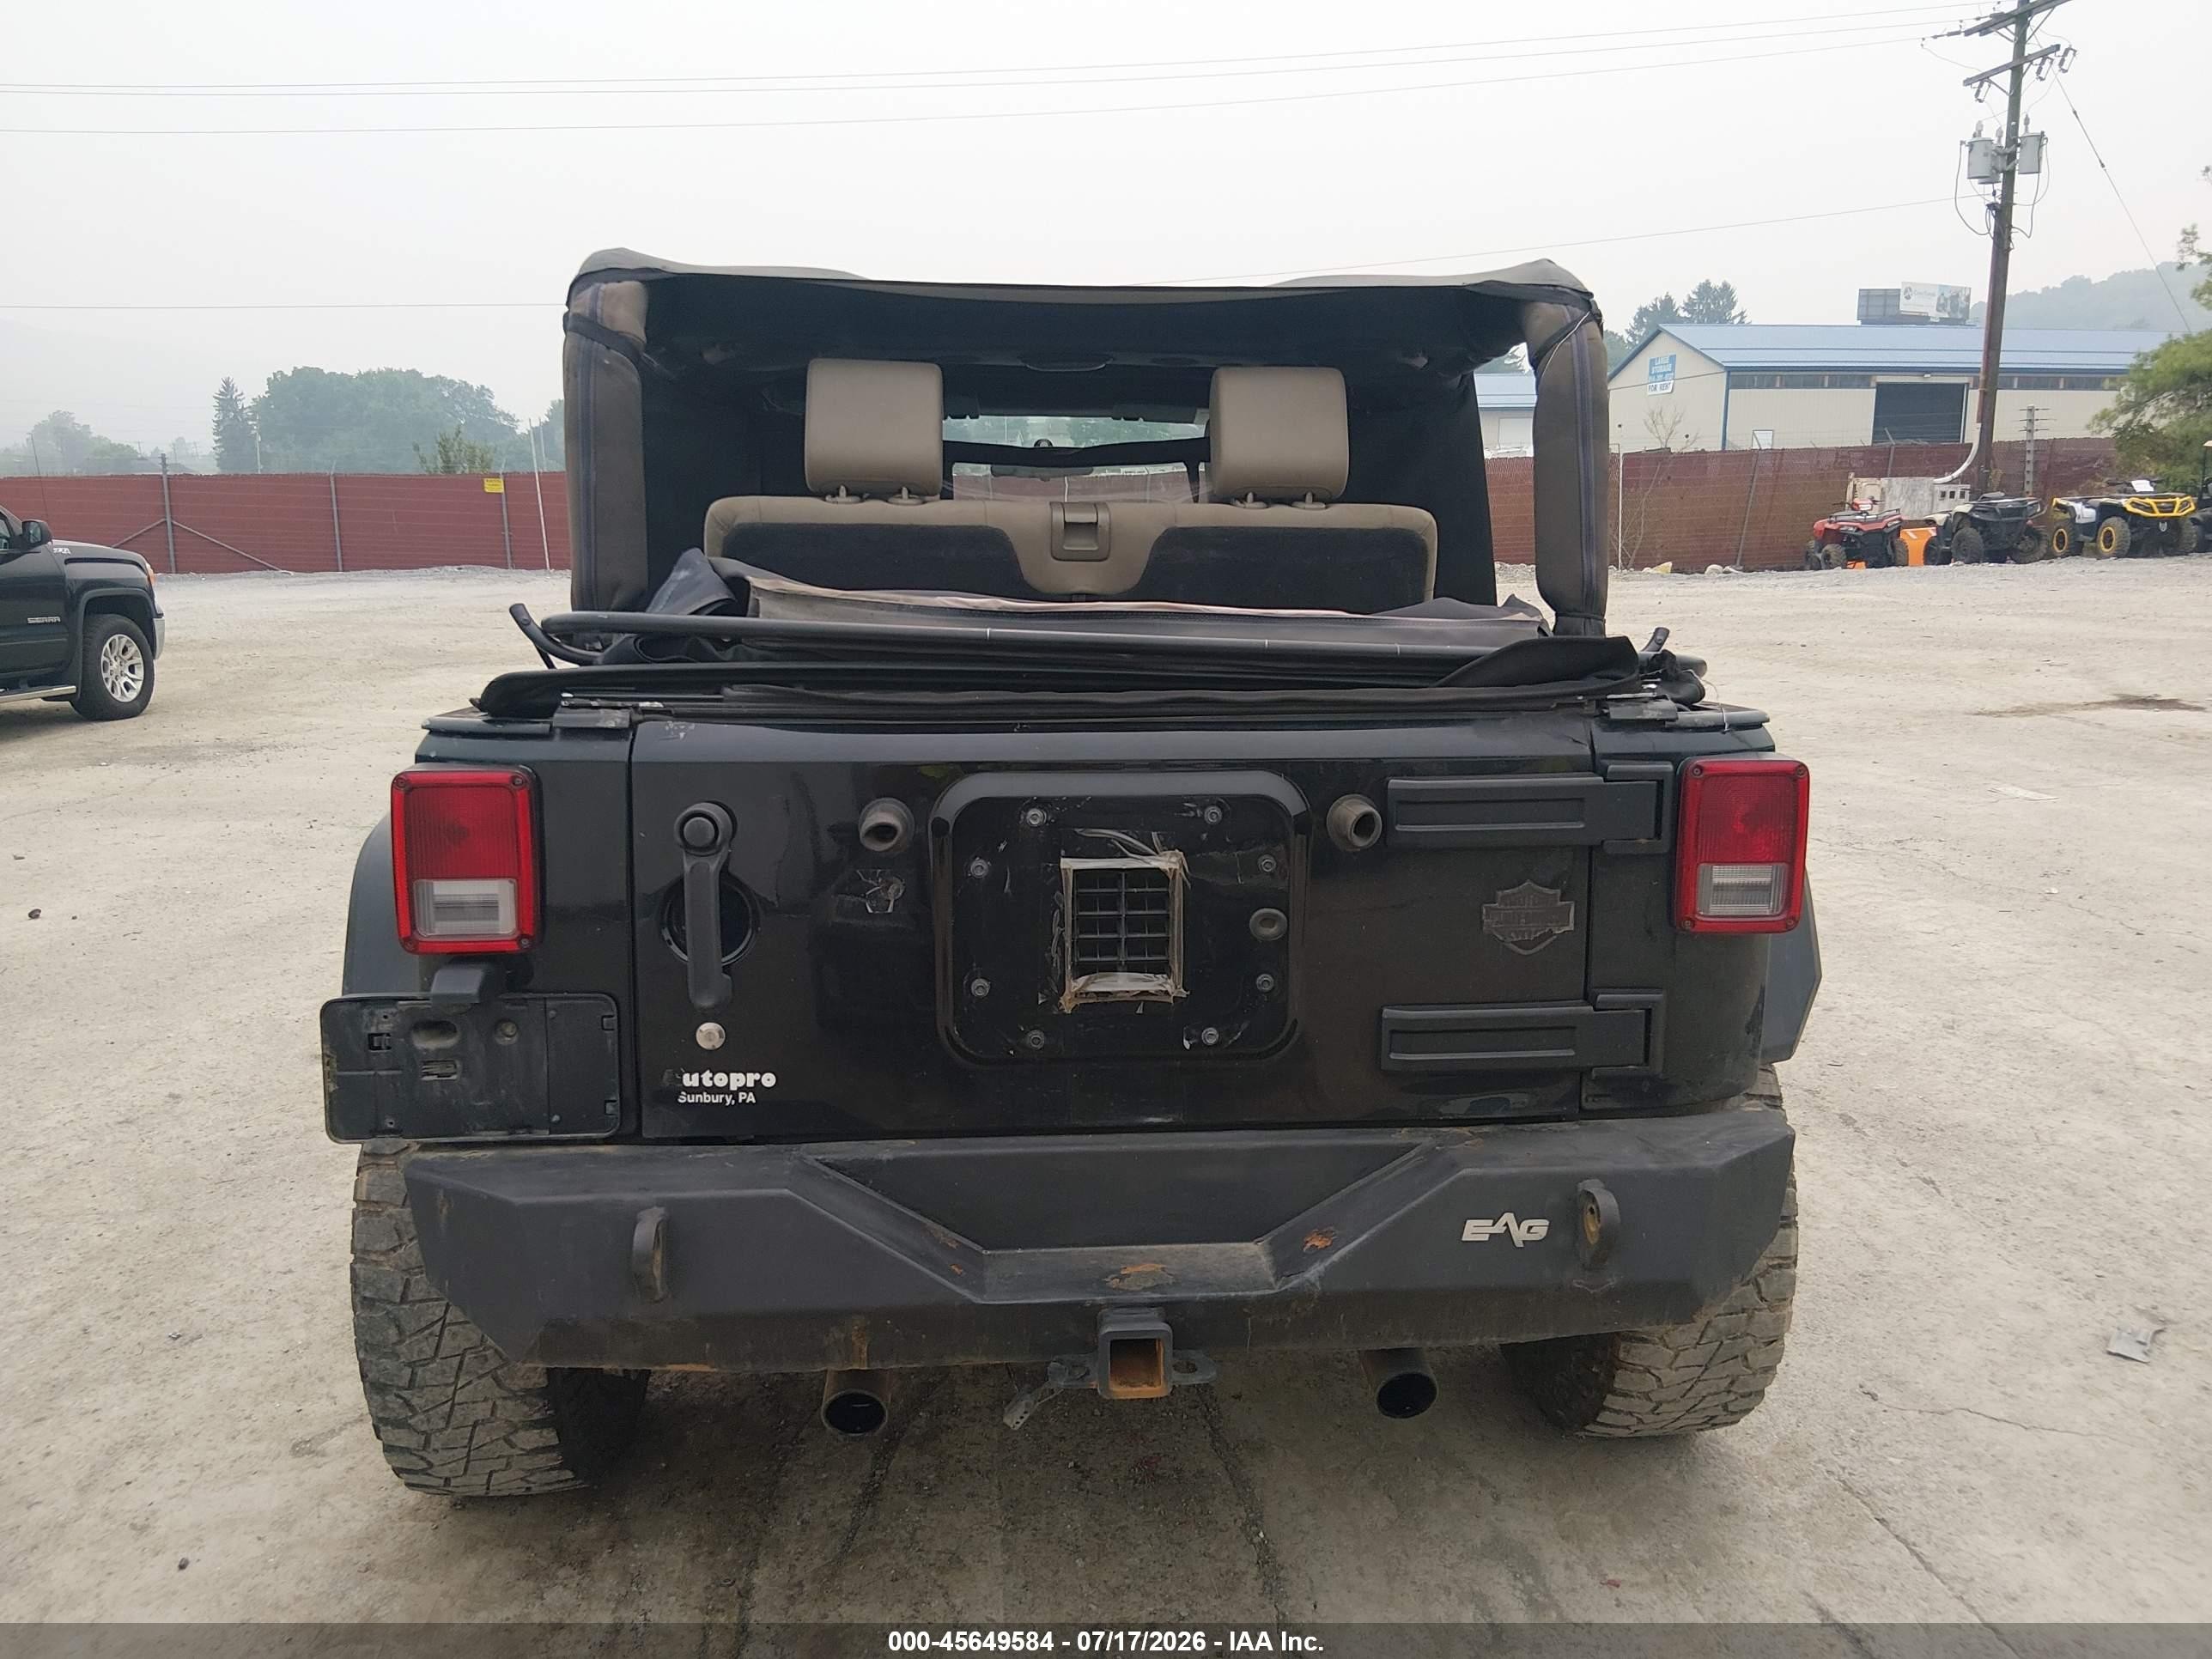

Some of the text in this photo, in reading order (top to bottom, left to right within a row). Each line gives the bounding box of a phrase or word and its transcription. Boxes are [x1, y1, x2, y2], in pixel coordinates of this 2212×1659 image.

[1649, 382, 1671, 392] FOR RENT
[27, 616, 61, 624] SIERRA
[678, 1091, 757, 1106] Sunbury, PA
[1462, 1212, 1550, 1248] EAG
